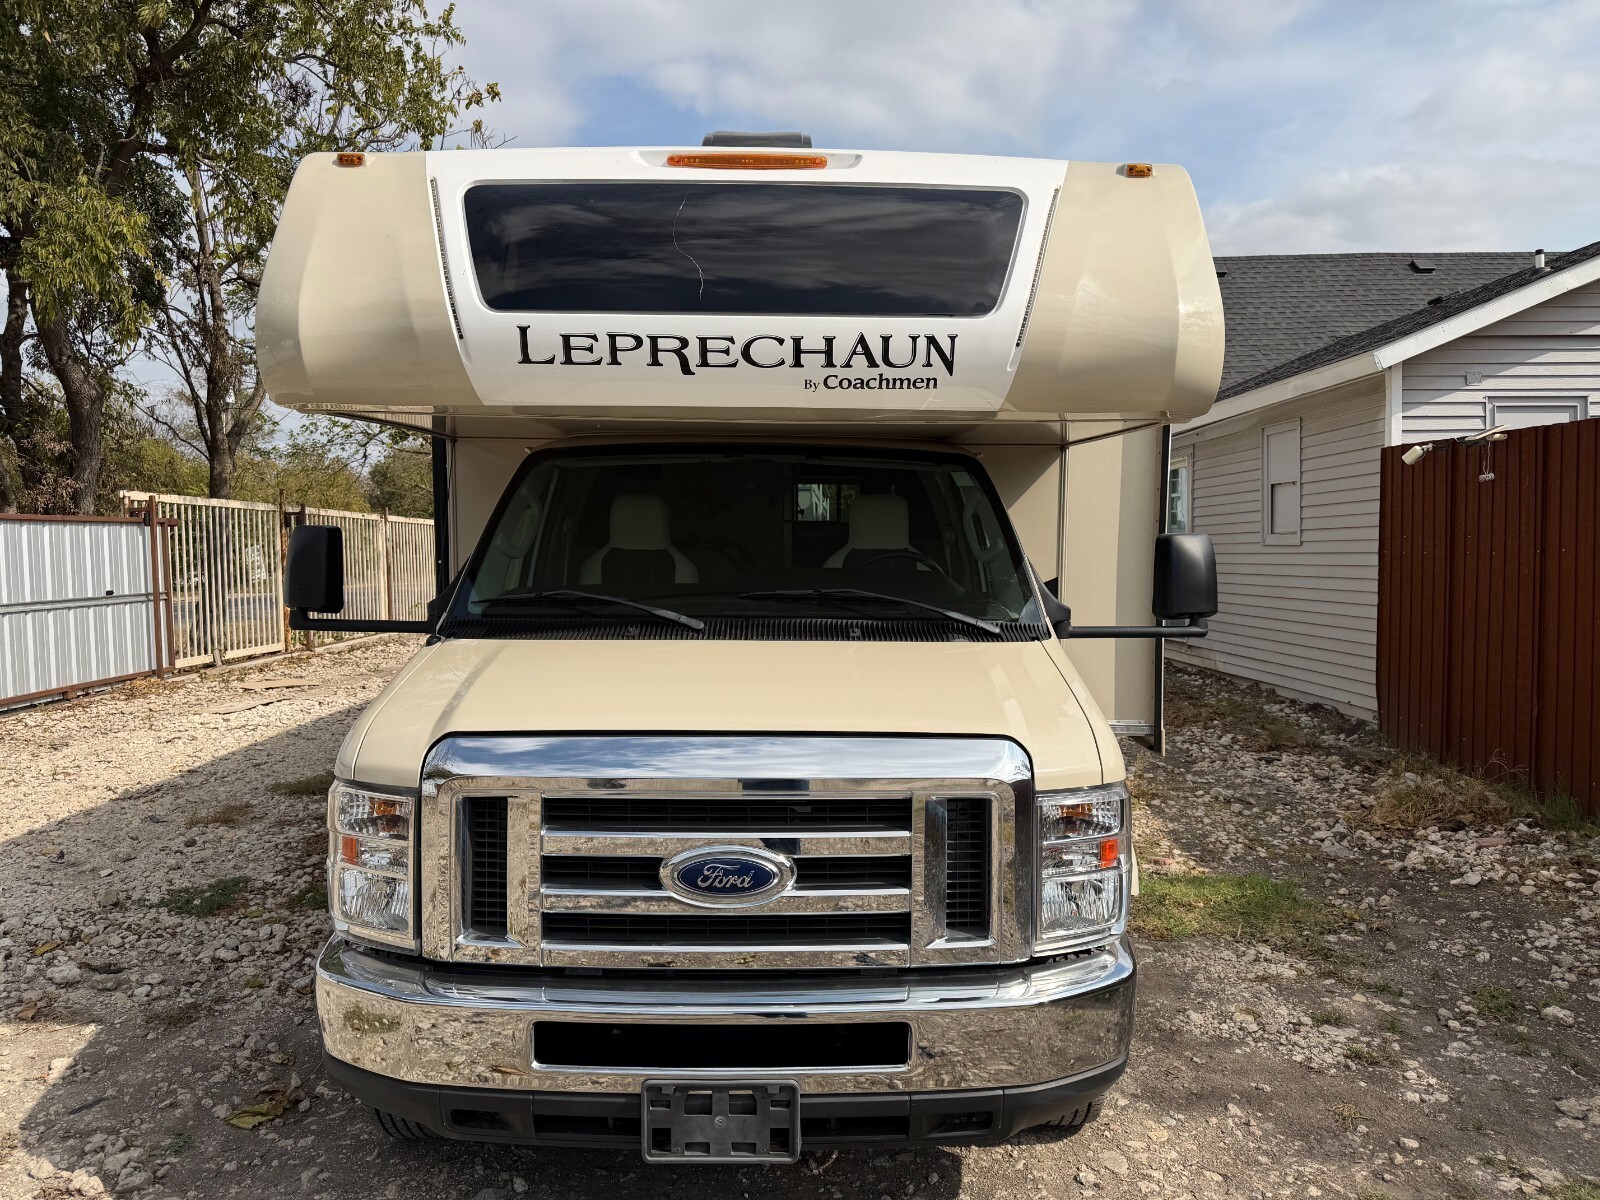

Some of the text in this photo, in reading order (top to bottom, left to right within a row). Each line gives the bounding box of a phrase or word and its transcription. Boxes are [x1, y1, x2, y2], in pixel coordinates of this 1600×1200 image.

[516, 325, 958, 376] LEPRECHAUN
[804, 374, 938, 392] By Coachmen
[698, 864, 754, 888] Ford
